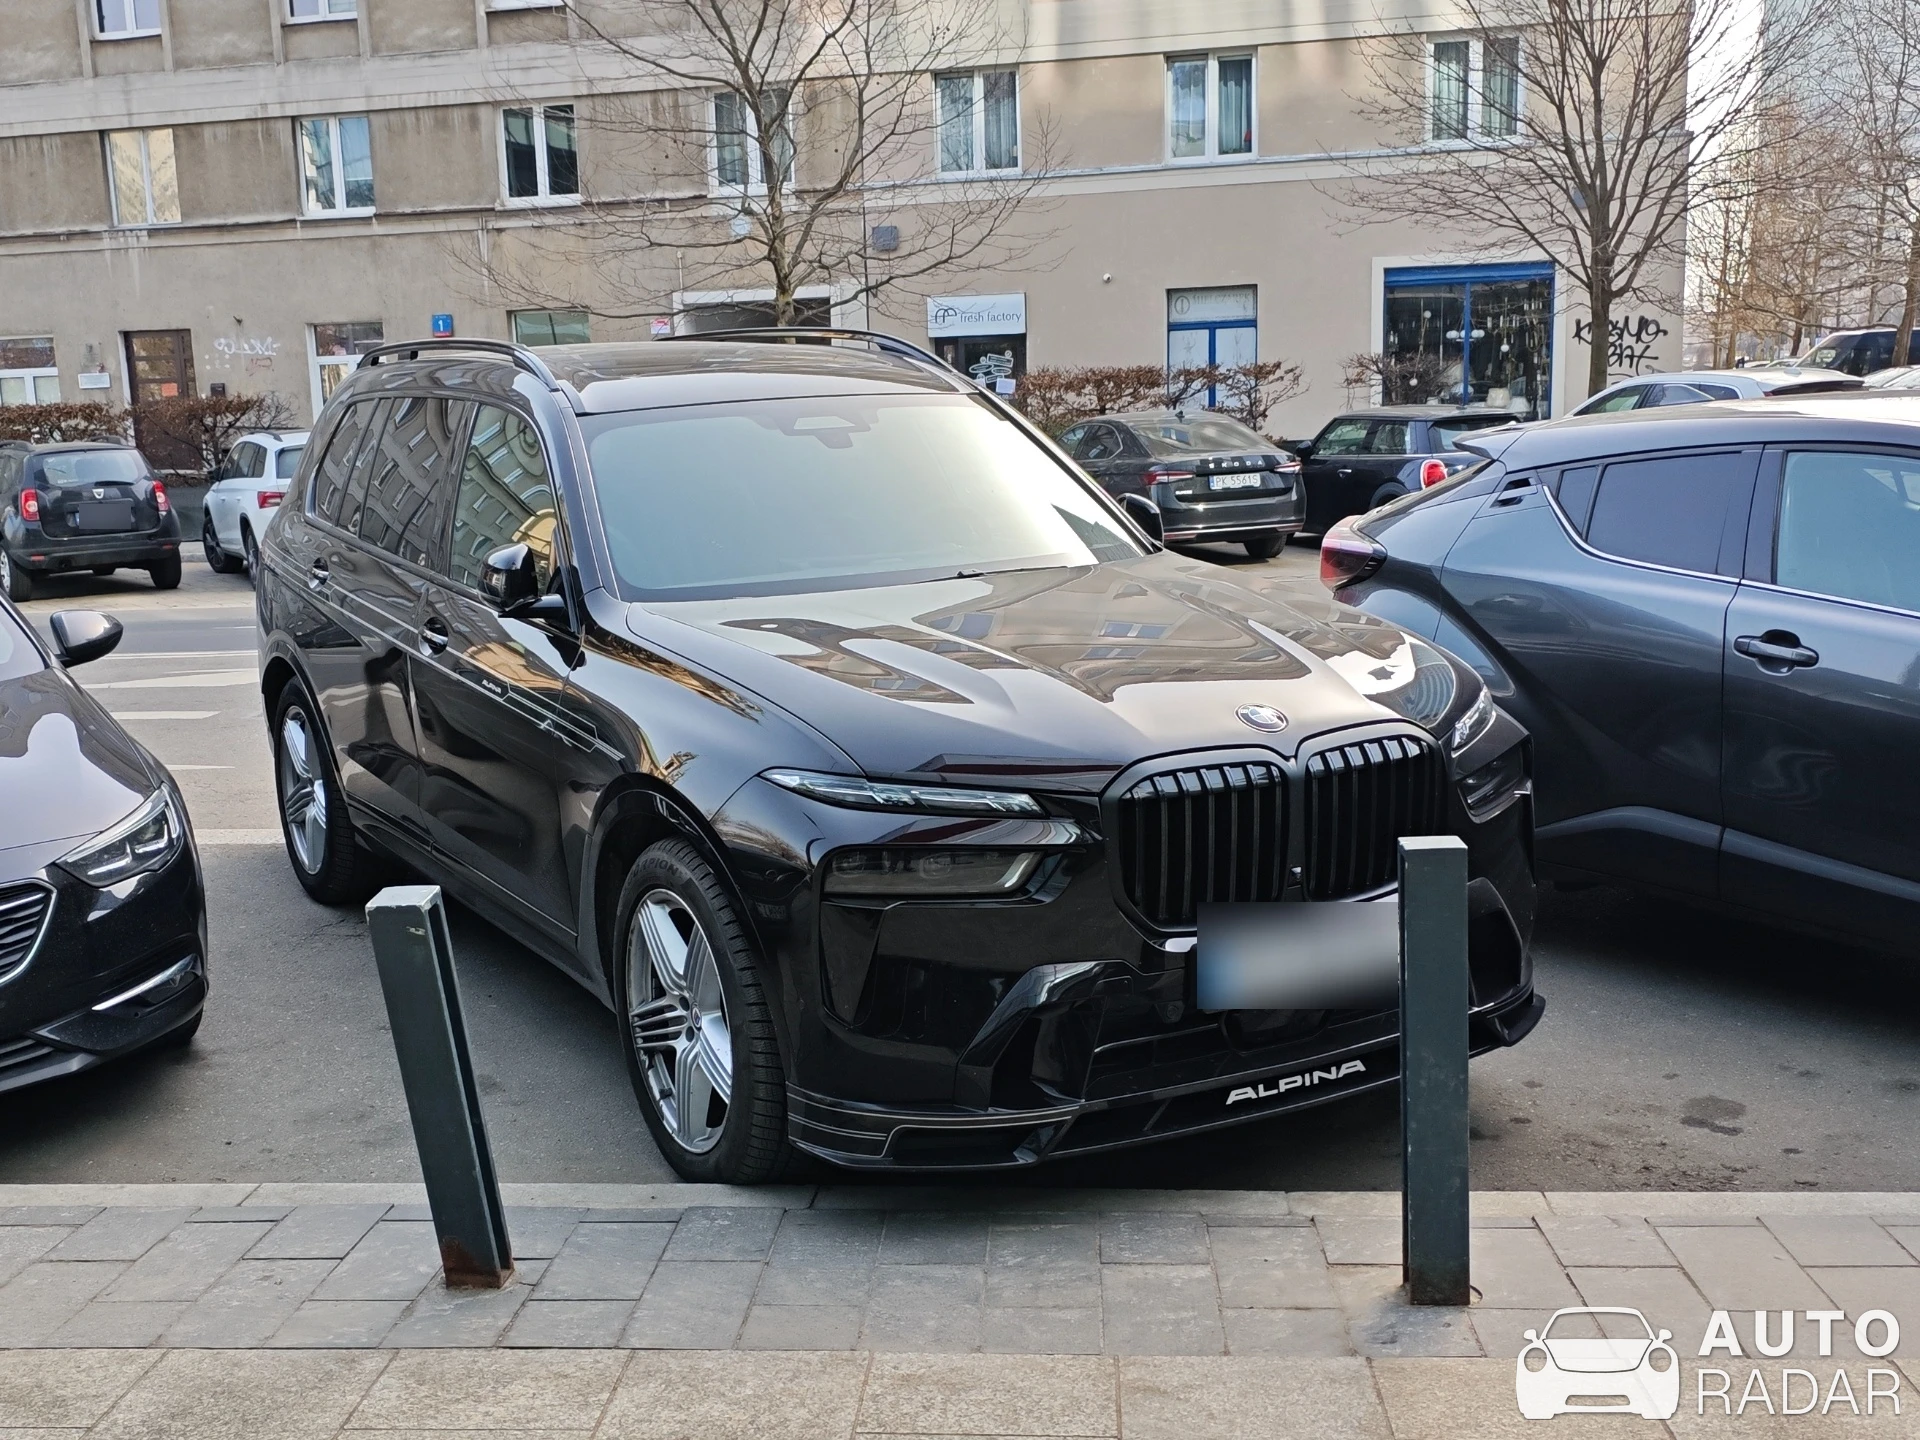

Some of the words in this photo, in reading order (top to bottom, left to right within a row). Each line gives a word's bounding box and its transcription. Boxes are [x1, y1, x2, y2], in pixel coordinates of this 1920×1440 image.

[960, 311, 984, 323] fresh
[987, 311, 1022, 323] factory
[1215, 476, 1227, 487] PK
[1226, 1059, 1366, 1105] ALPINA
